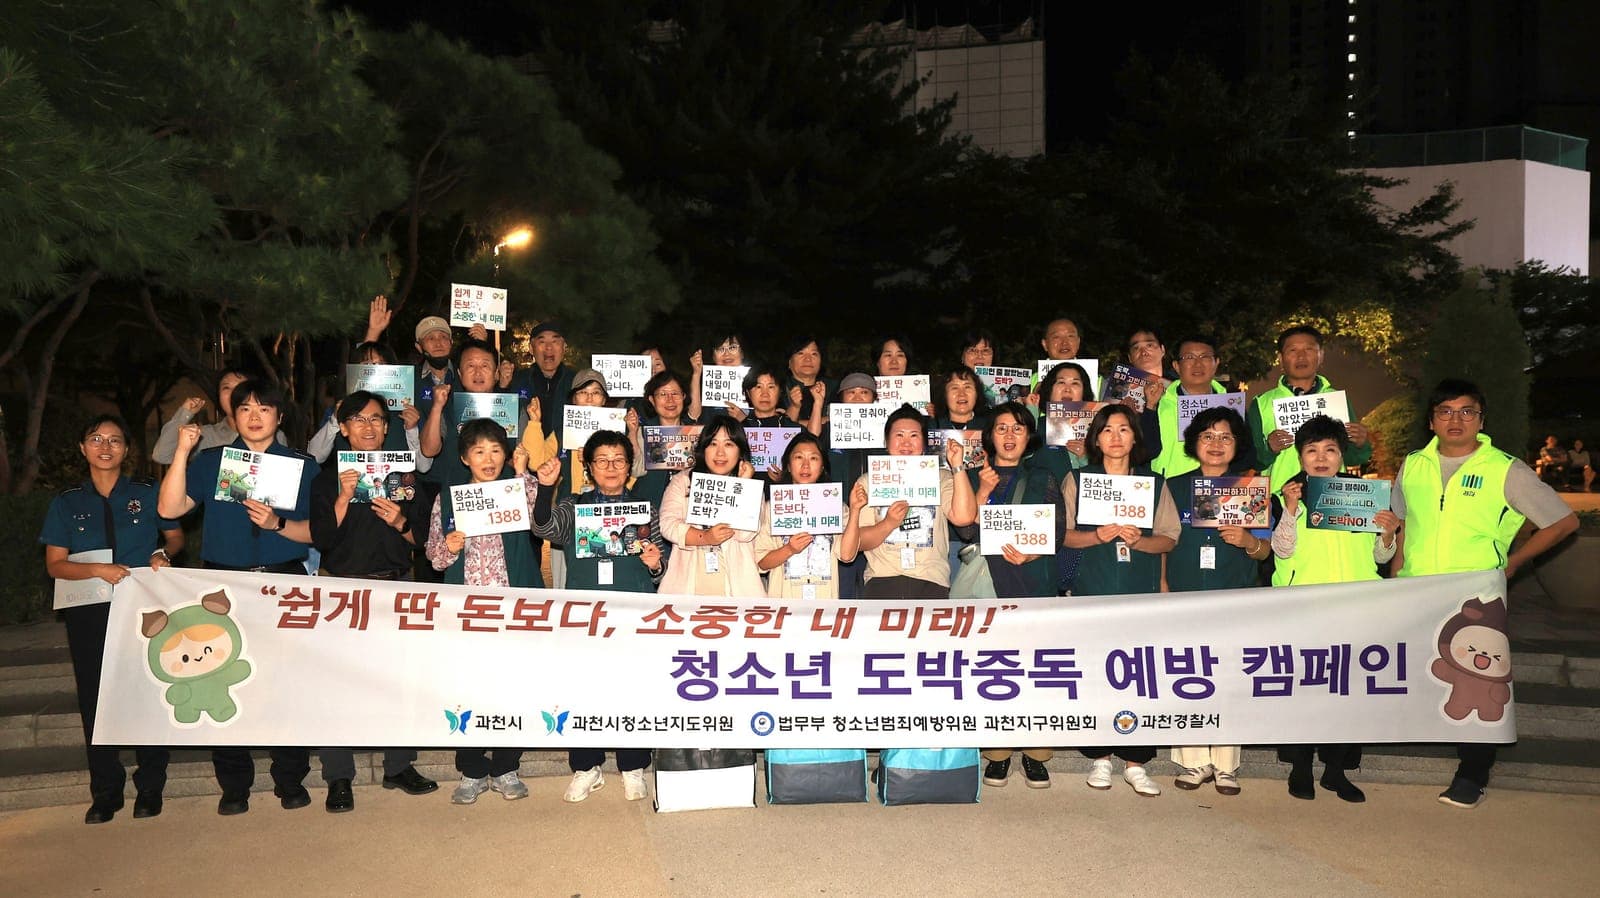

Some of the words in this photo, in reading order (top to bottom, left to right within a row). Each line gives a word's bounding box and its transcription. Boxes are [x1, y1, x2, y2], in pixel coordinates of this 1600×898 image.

[454, 300, 481, 311] 돈보,
[453, 311, 476, 322] 소중한
[706, 369, 722, 380] 지금
[606, 381, 634, 391] 습니다.
[706, 380, 731, 390] 내일이
[705, 391, 742, 402] 있습니다.
[1181, 398, 1208, 409] 청소년
[1278, 400, 1310, 413] 게임인
[834, 408, 853, 418] 지금
[1181, 409, 1200, 419] 고민
[763, 432, 773, 441] 딴
[835, 432, 874, 442] 있습니다.
[750, 444, 769, 454] 보다,
[224, 449, 251, 462] 게임인
[339, 452, 365, 463] 게임인
[751, 455, 765, 466] 중한
[872, 460, 891, 471] 쉽게
[872, 474, 905, 485] 돈보다,
[1083, 477, 1113, 489] 청소년
[1194, 480, 1214, 488] 도박,
[695, 478, 726, 492] 게임인
[733, 482, 743, 494] 줄
[1328, 483, 1343, 491] 지금
[454, 488, 483, 501] 청소년
[774, 489, 793, 500] 쉽게
[799, 488, 809, 500] 딴
[872, 487, 899, 499] 소중한
[904, 487, 914, 498] 내
[918, 487, 937, 498] 미래
[1082, 489, 1126, 502] 고민상담,
[1214, 488, 1248, 496] 고민하지
[456, 498, 499, 512] 고민상담,
[694, 491, 738, 508] 알았는데,
[577, 505, 602, 517] 게임인
[614, 504, 649, 516] 알았는데,
[691, 505, 719, 518] 도박?
[774, 503, 808, 515] 돈보다,
[983, 509, 1012, 519] 청소년
[1113, 504, 1146, 518] 1388
[488, 509, 522, 524] 1388
[603, 517, 626, 527] 도박?
[774, 517, 803, 529] 소중한
[807, 517, 816, 528] 내
[821, 515, 839, 528] 미래
[1328, 515, 1367, 527] 도박NO!
[983, 520, 1026, 531] 고민상담,
[1014, 533, 1047, 545] 1388
[394, 591, 441, 630] 딴
[457, 595, 616, 638] 돈보다,
[636, 603, 792, 639] 소중한
[810, 606, 858, 640] 내
[670, 649, 833, 701] 청소년
[857, 648, 1083, 701] 도박중독
[1105, 645, 1219, 700] 예방
[1242, 642, 1408, 697] 캠페인
[475, 715, 522, 731] 과천시
[572, 715, 734, 732] 과천시청소년지도위원
[778, 716, 825, 732] 법무부
[832, 715, 977, 732] 청소년범죄예방위원
[984, 715, 1097, 731] 과천지구위원회
[1141, 713, 1220, 730] 과천경찰서
